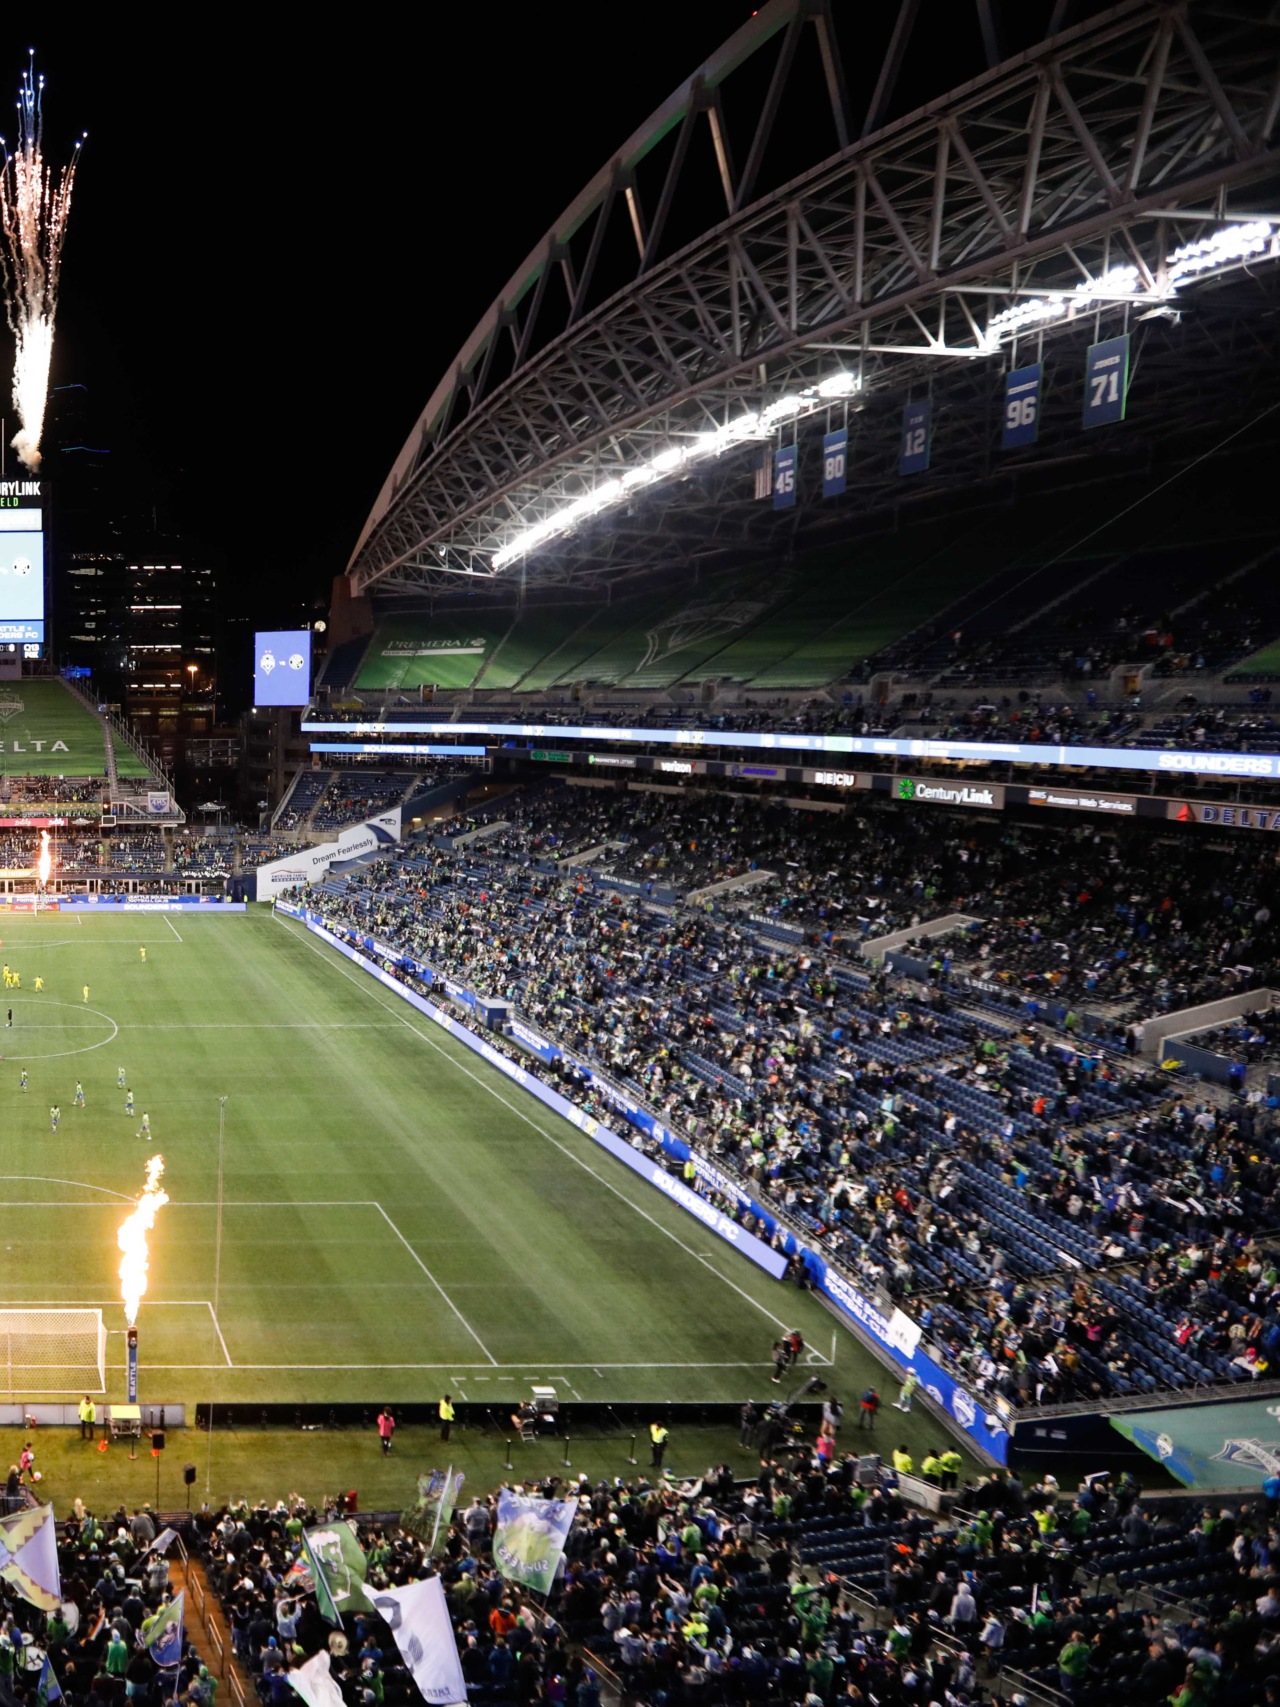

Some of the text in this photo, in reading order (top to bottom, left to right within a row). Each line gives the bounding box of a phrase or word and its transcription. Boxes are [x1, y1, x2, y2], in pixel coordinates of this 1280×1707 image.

[1090, 371, 1119, 407] 71
[1006, 396, 1037, 429] 96
[903, 428, 926, 457] 12
[824, 454, 845, 481] 80
[775, 470, 794, 494] 45
[25, 631, 39, 639] FC
[388, 639, 461, 648] PREMERA
[660, 760, 692, 773] verizon
[1158, 754, 1272, 774] SOUNDERS
[916, 783, 994, 805] CenturyLink
[1028, 790, 1047, 800] aws
[1078, 797, 1098, 807] Web
[1098, 799, 1133, 811] Services
[312, 838, 374, 865] Dream Fearlessly
[123, 903, 169, 911] SOUNDERS
[652, 1169, 739, 1240] SOUNDERS FC
[825, 1267, 864, 1308] SEATTLE
[824, 1276, 871, 1325] FOOTBALL
